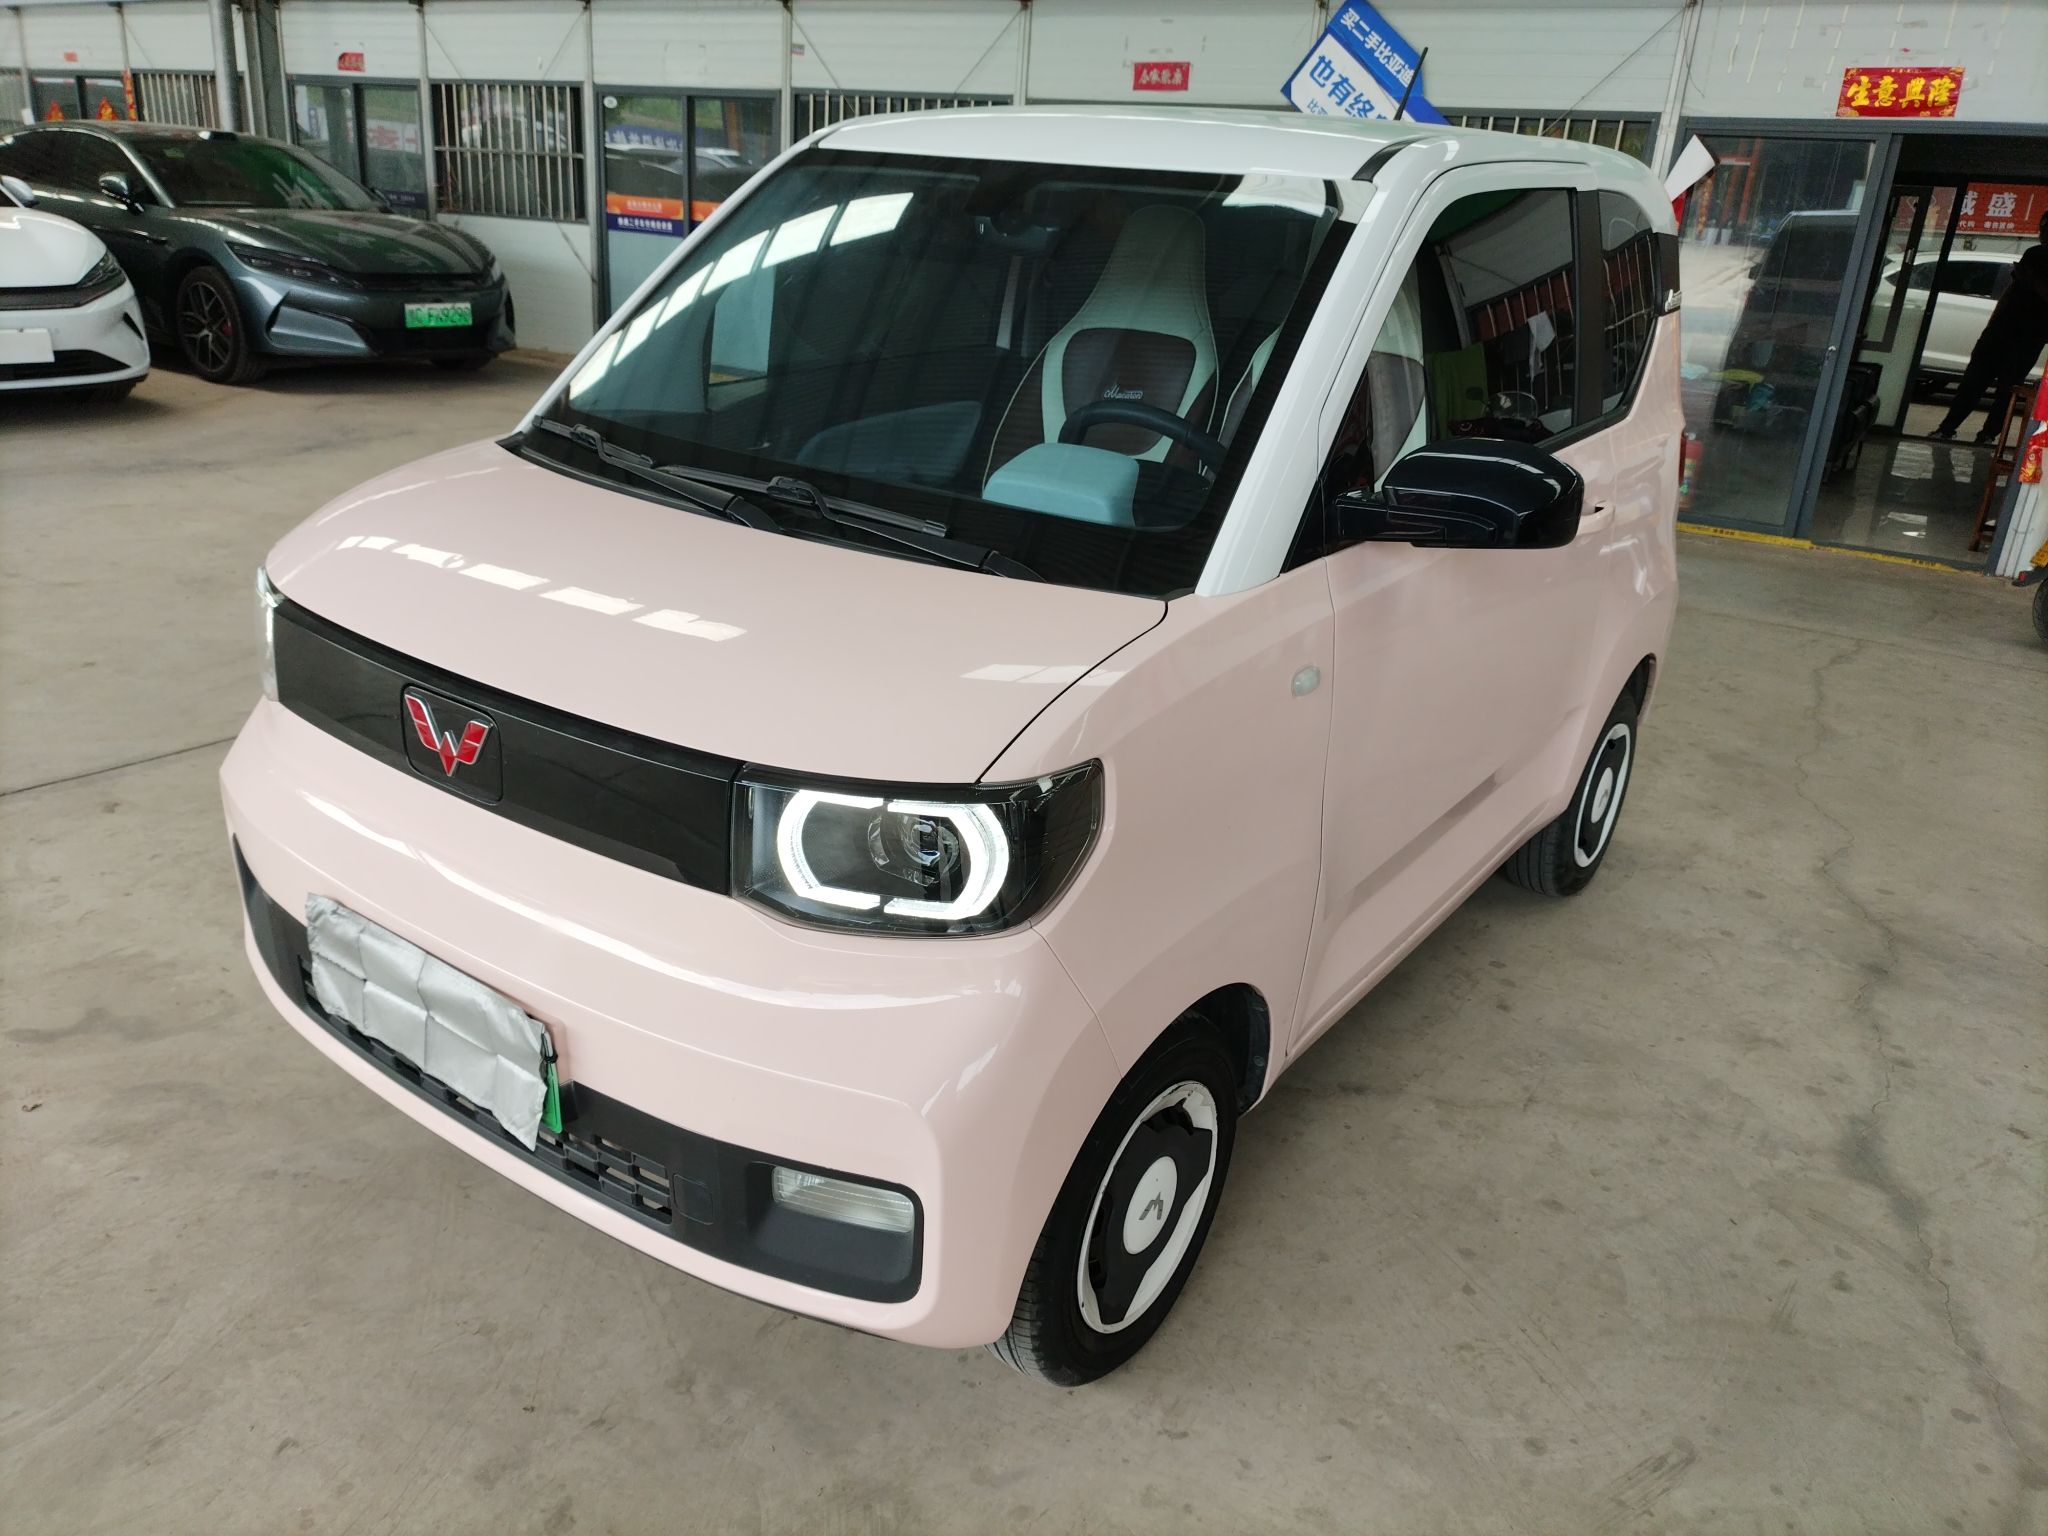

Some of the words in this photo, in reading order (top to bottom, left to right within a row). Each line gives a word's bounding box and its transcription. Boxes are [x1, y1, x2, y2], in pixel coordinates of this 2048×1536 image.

[1340, 7, 1416, 88] 买二手比亚迪
[1309, 54, 1387, 119] 也有终
